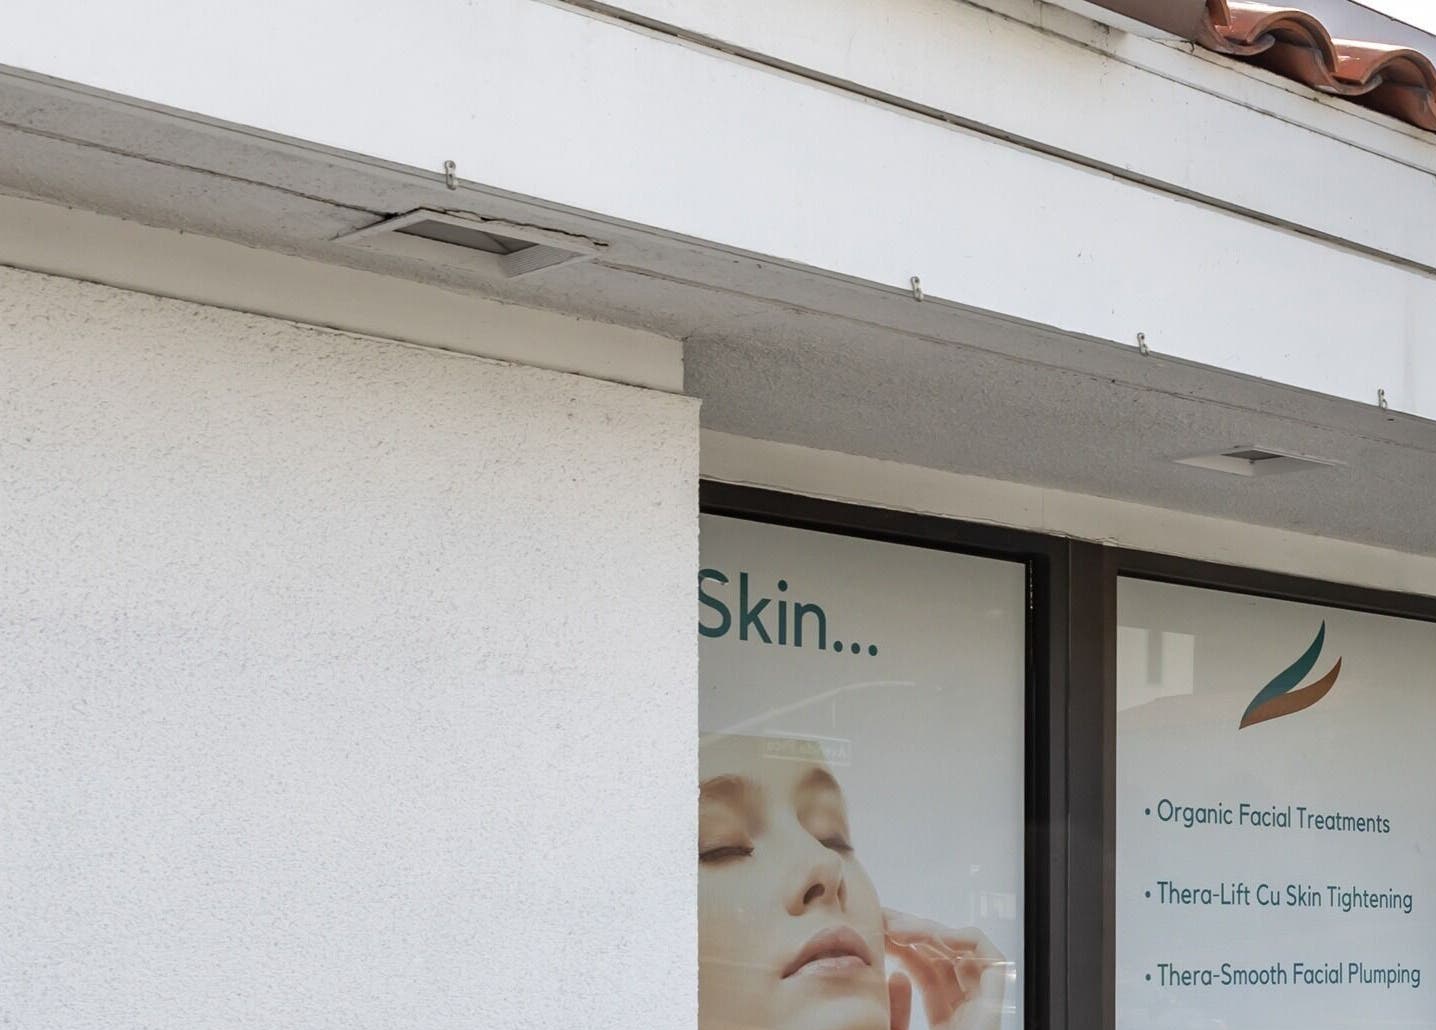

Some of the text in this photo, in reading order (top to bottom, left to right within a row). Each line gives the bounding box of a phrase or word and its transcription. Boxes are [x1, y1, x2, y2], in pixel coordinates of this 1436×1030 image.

[698, 568, 879, 656] Skin...
[1157, 799, 1390, 833] Organic Facial Treatments
[1157, 881, 1413, 913] Thera-Lift Cu Skin Tightening
[1157, 962, 1421, 988] Thera-Smooth Facial Plumping
